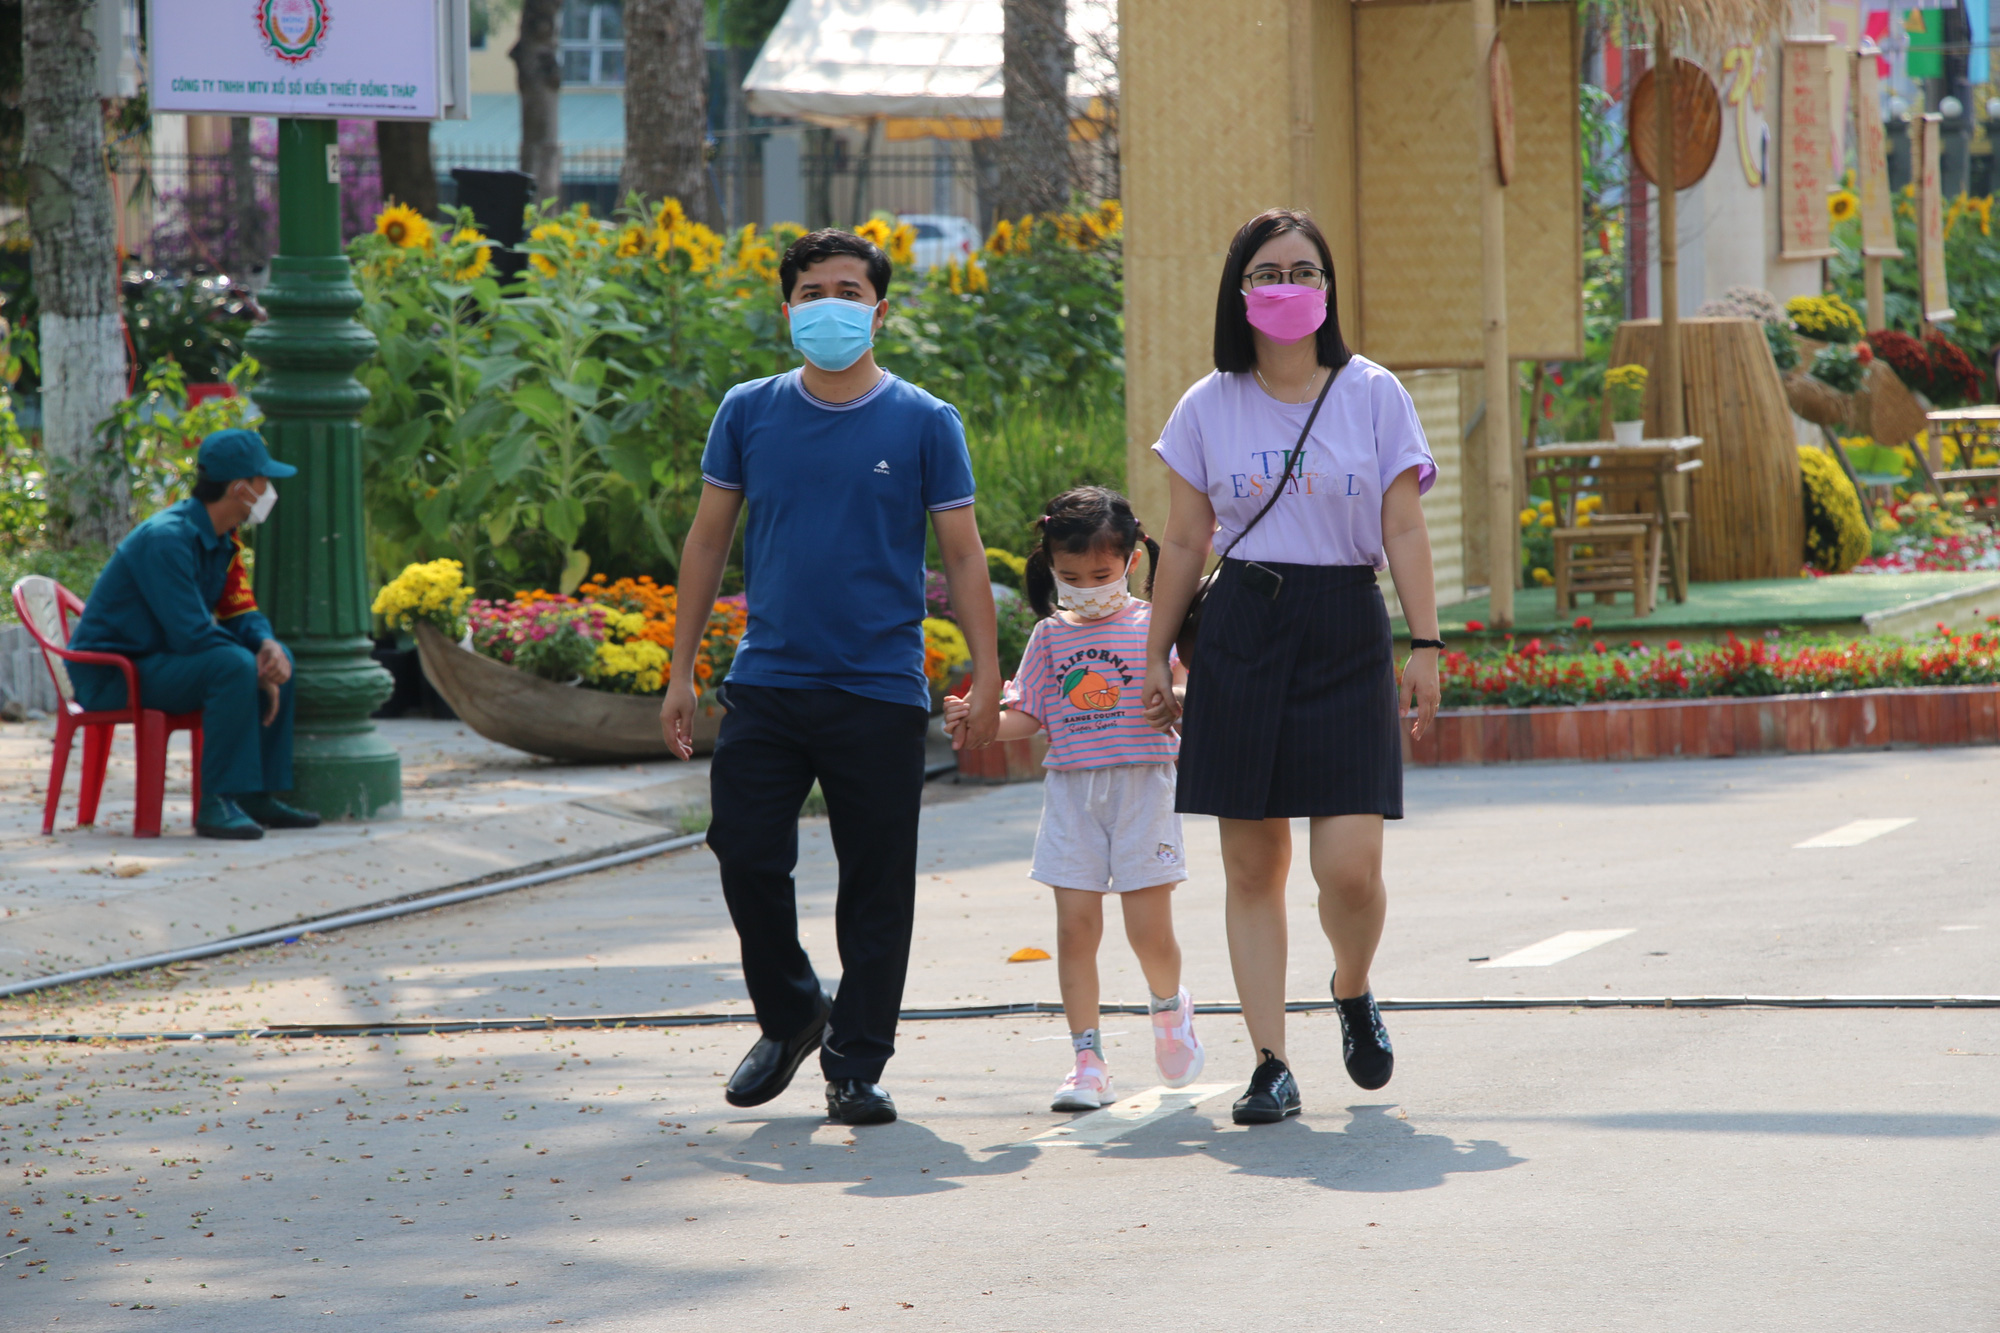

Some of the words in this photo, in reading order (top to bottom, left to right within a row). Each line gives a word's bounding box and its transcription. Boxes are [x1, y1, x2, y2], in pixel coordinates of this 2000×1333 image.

[171, 77, 200, 92] CÔNG
[202, 79, 215, 92] TY
[218, 80, 245, 93] TNHH
[247, 81, 269, 94] MTV
[288, 77, 302, 96] SỐ
[304, 77, 328, 96] KIẾN
[330, 79, 357, 97] THIẾT
[360, 79, 388, 97] ĐỒNG
[390, 82, 417, 98] THÁP
[1056, 649, 1133, 694] ALIFORNIA
[1063, 714, 1091, 723] RANGE
[1093, 711, 1126, 719] COUNTY
